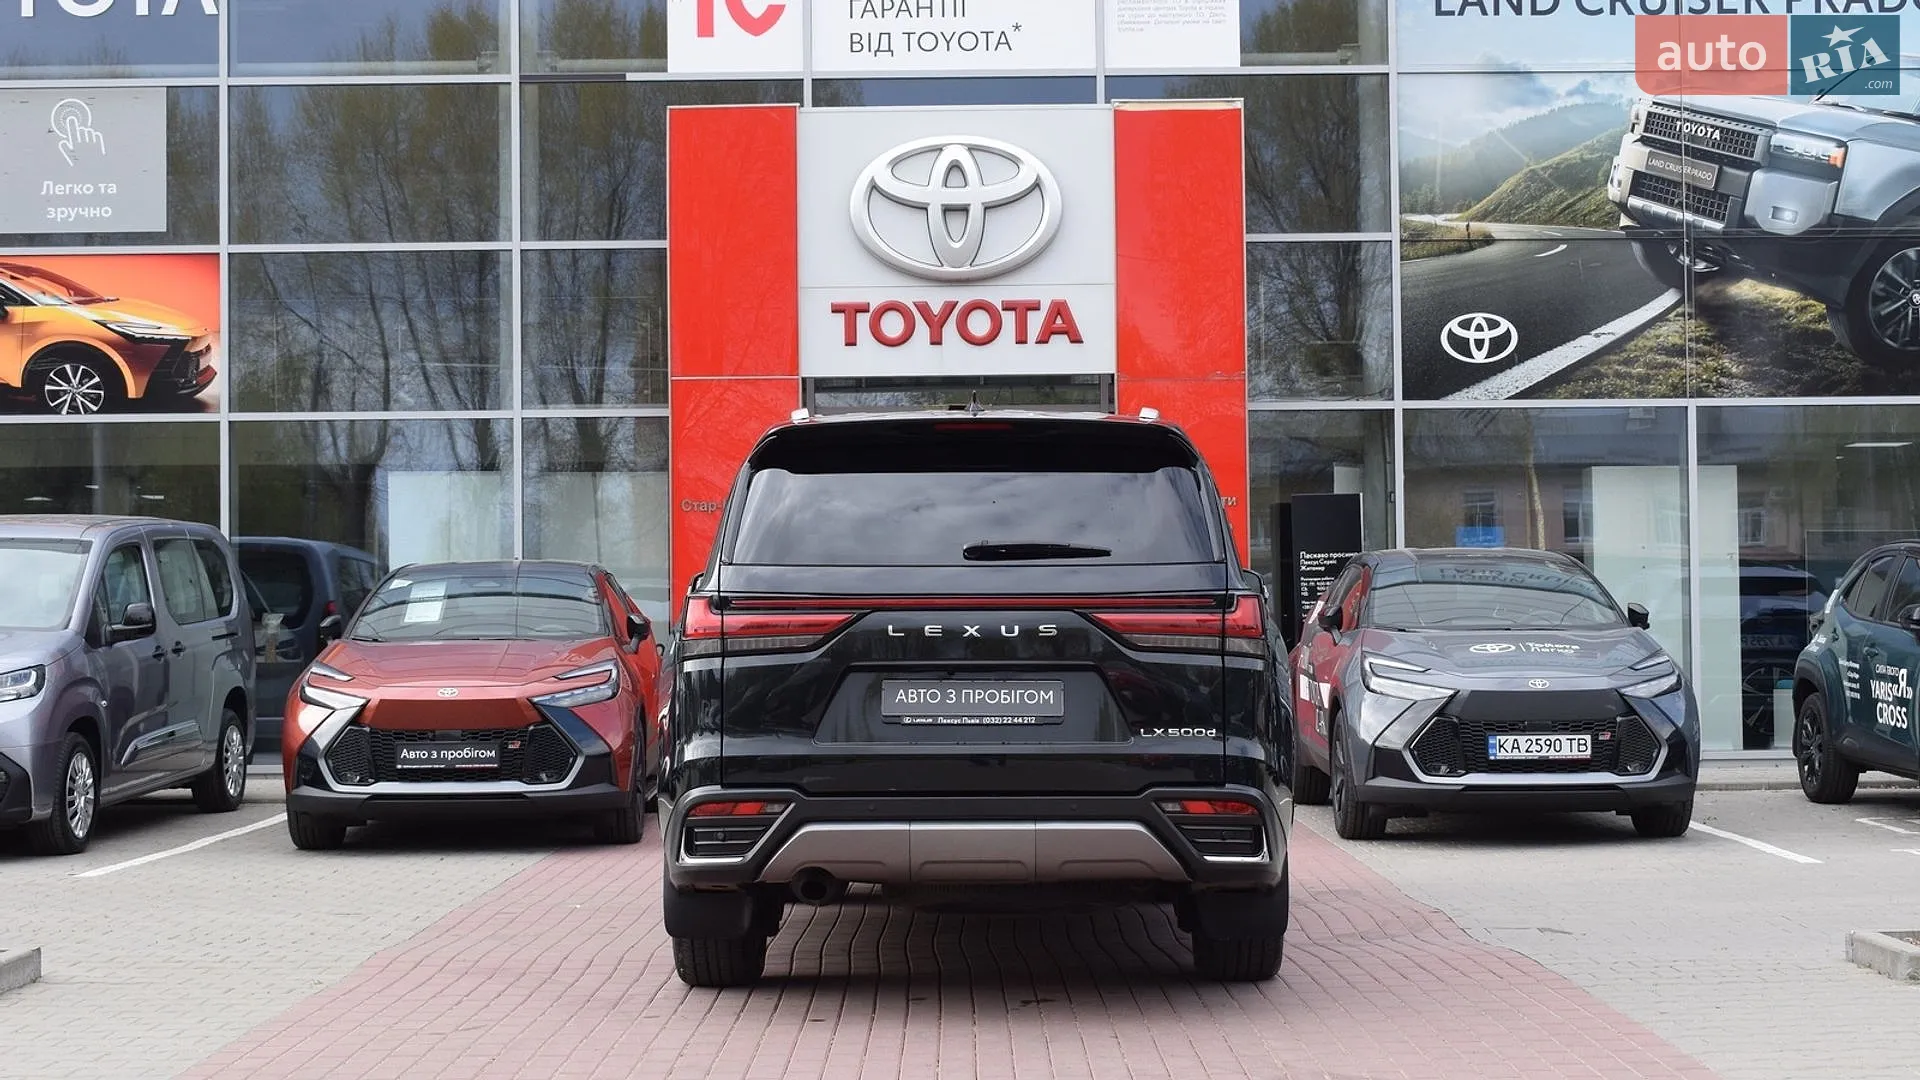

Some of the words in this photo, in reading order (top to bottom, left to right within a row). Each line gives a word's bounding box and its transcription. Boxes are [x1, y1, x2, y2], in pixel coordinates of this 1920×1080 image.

[850, 32, 893, 57] ВІД
[1676, 121, 1720, 140] TOYOTA
[1647, 158, 1664, 168] LAND
[41, 181, 94, 195] Легко
[98, 183, 117, 194] та
[46, 205, 112, 222] зручно
[831, 299, 1084, 347] TOYOTA
[887, 624, 1058, 637] LEXUS
[895, 689, 941, 704] АВТО
[961, 689, 1054, 705] ПРОБІГОМ
[1870, 680, 1893, 701] YARIS
[1876, 702, 1908, 729] CROSS
[1498, 738, 1521, 753] KA
[1525, 738, 1562, 753] 2590
[1566, 738, 1588, 753] TB
[400, 748, 429, 759] Авто
[430, 749, 438, 759] з
[440, 747, 496, 761] пробігом
